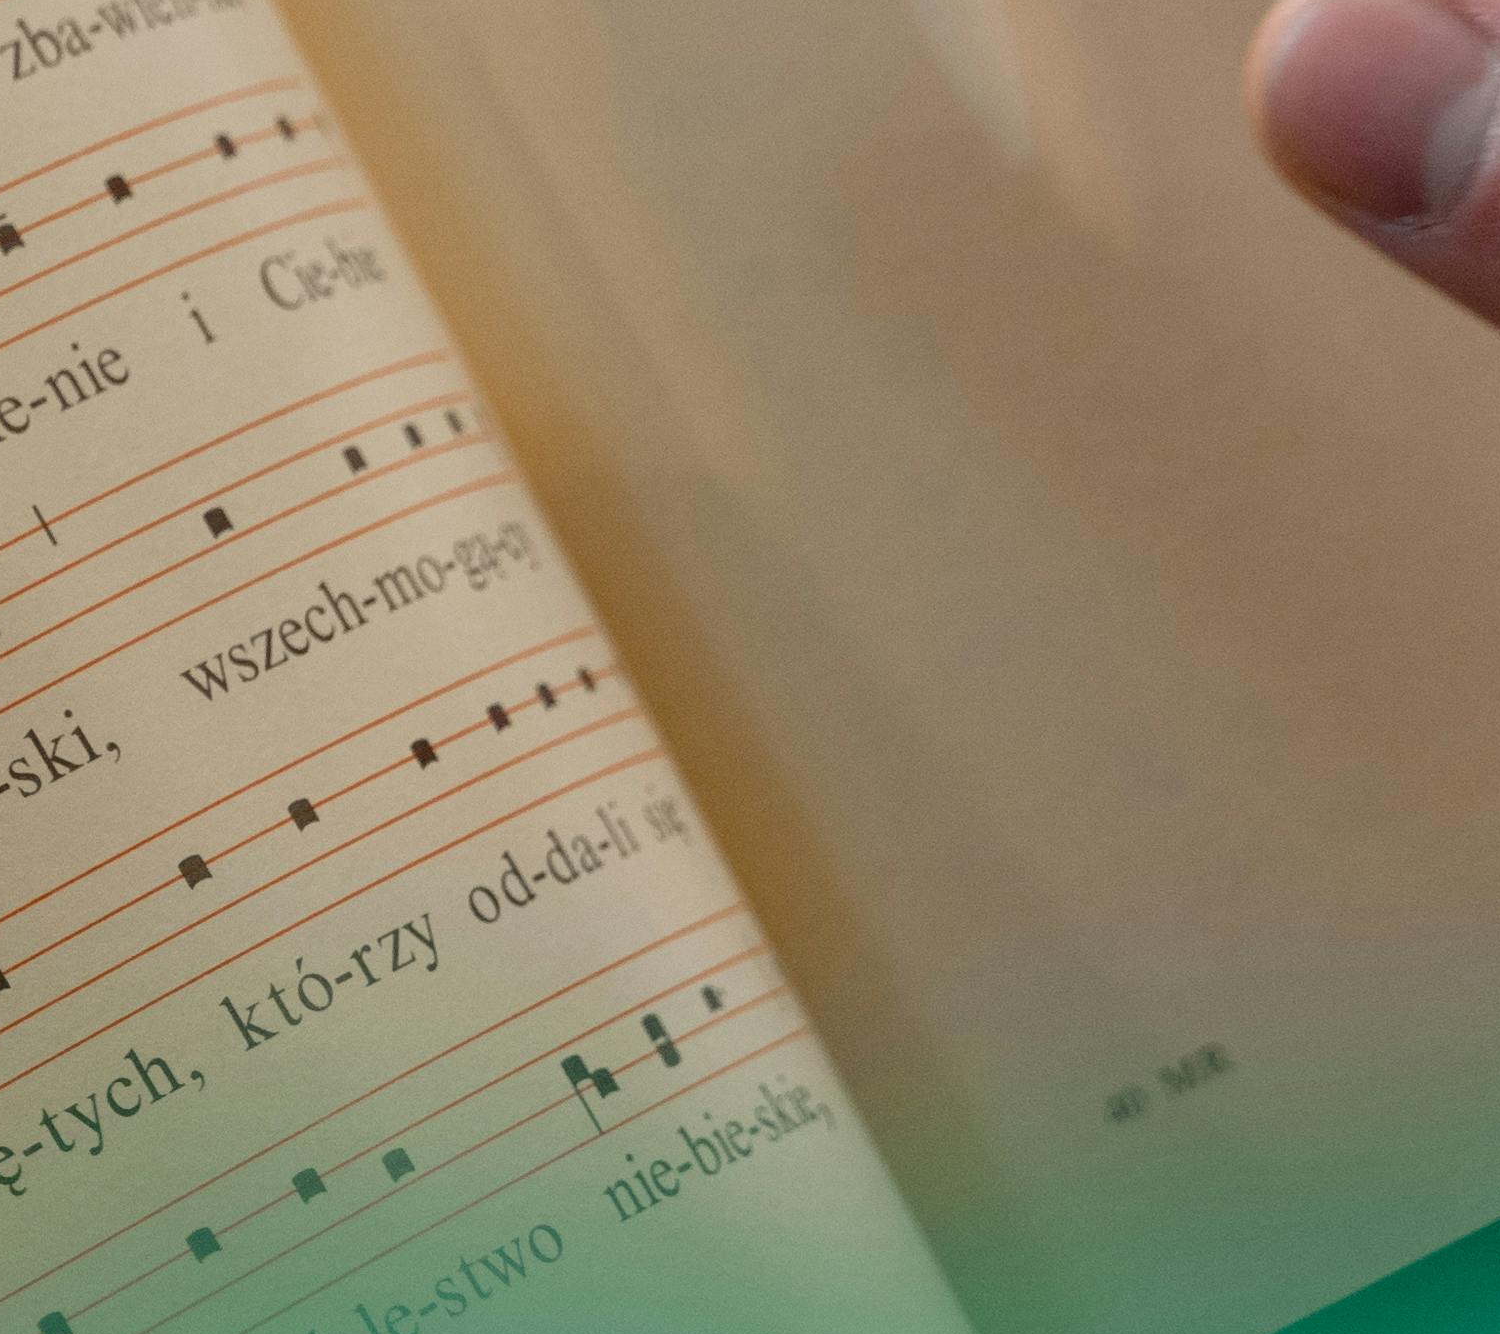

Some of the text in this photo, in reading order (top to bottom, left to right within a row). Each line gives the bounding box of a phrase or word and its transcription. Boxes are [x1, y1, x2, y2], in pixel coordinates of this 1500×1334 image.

[180, 291, 216, 345] i
[218, 910, 441, 1052] któ-rzy
[467, 801, 641, 925] od-da-li
